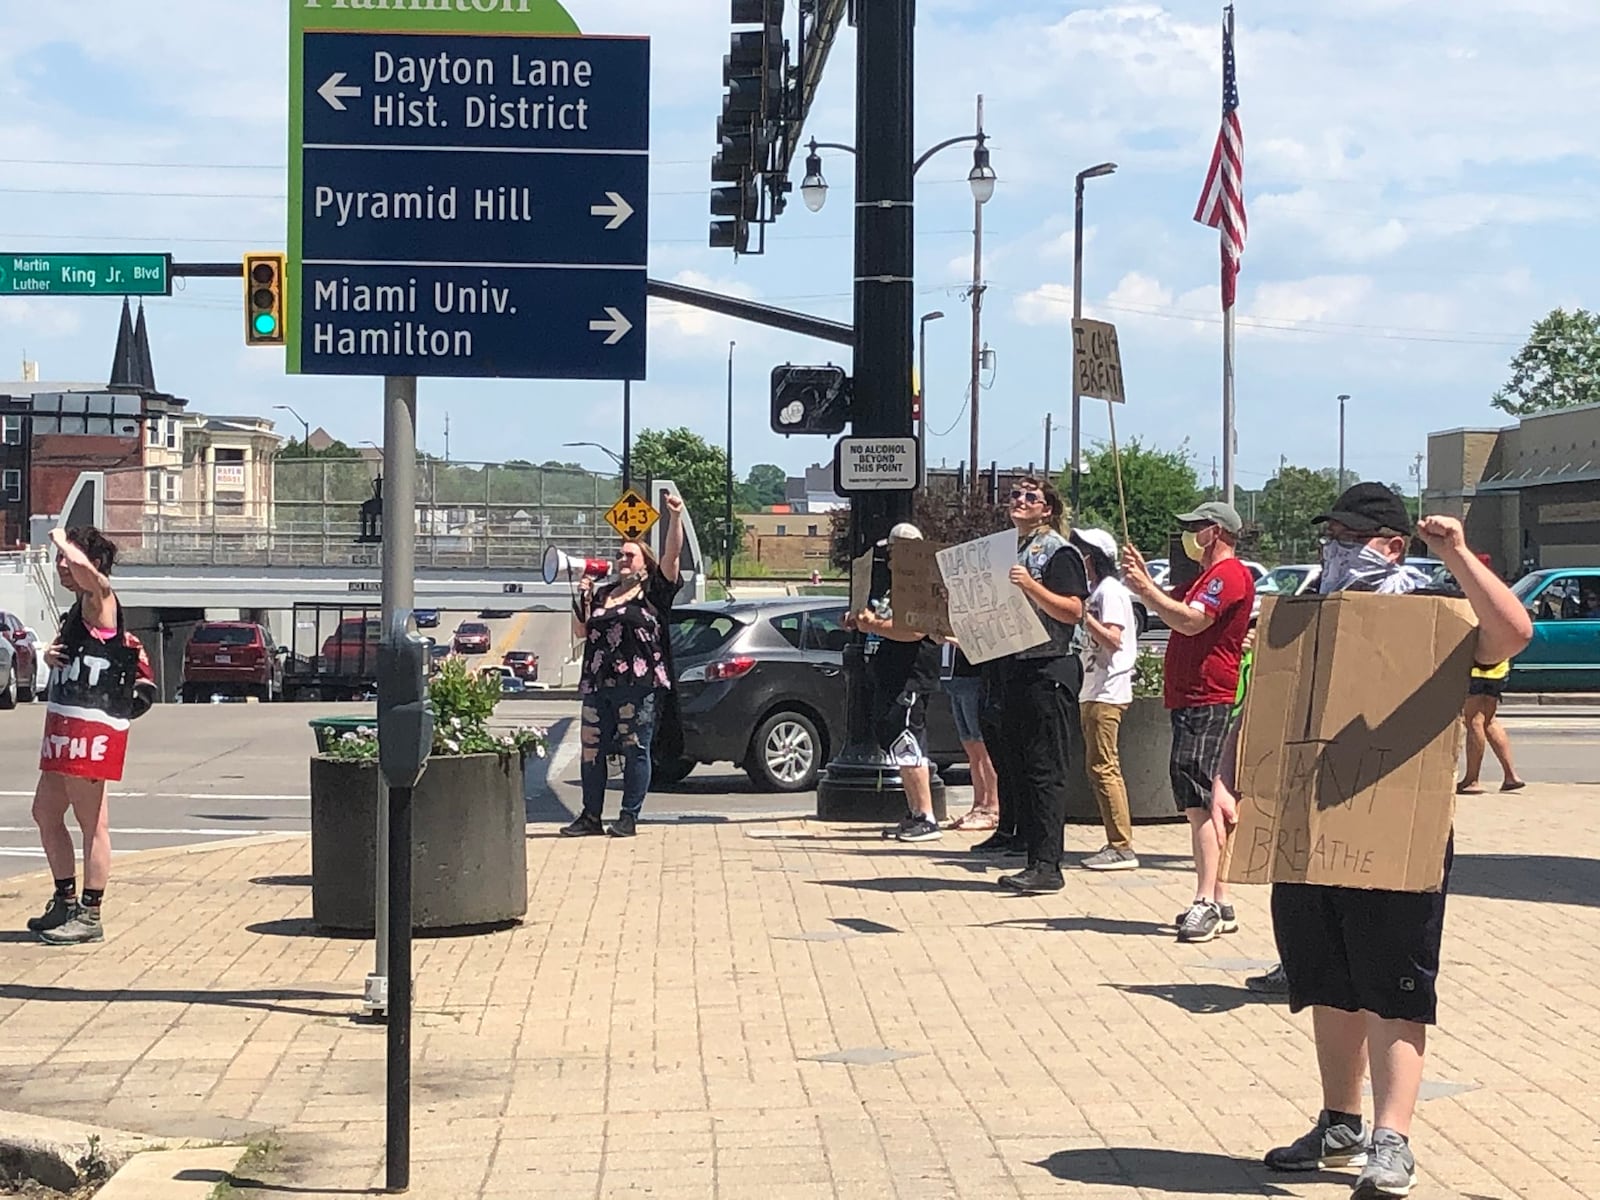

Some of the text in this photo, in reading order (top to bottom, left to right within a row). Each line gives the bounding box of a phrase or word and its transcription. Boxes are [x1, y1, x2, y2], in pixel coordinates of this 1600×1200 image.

[373, 51, 593, 92] Dayton Lane
[373, 92, 589, 130] Hist. District
[315, 185, 532, 226] Pyramid Hill
[13, 258, 50, 272] Martin
[62, 266, 160, 288] King Jr. Blvd
[13, 278, 50, 290] Luther
[314, 278, 517, 314] Miami Univ.
[314, 323, 472, 356] Hamilton
[1074, 327, 1086, 355] I
[850, 445, 906, 454] NO ALCOHOL
[859, 454, 895, 463] BEYOND
[853, 463, 903, 472] THIS POINT
[1286, 597, 1350, 745] I
[1241, 826, 1375, 878] BREATHE
